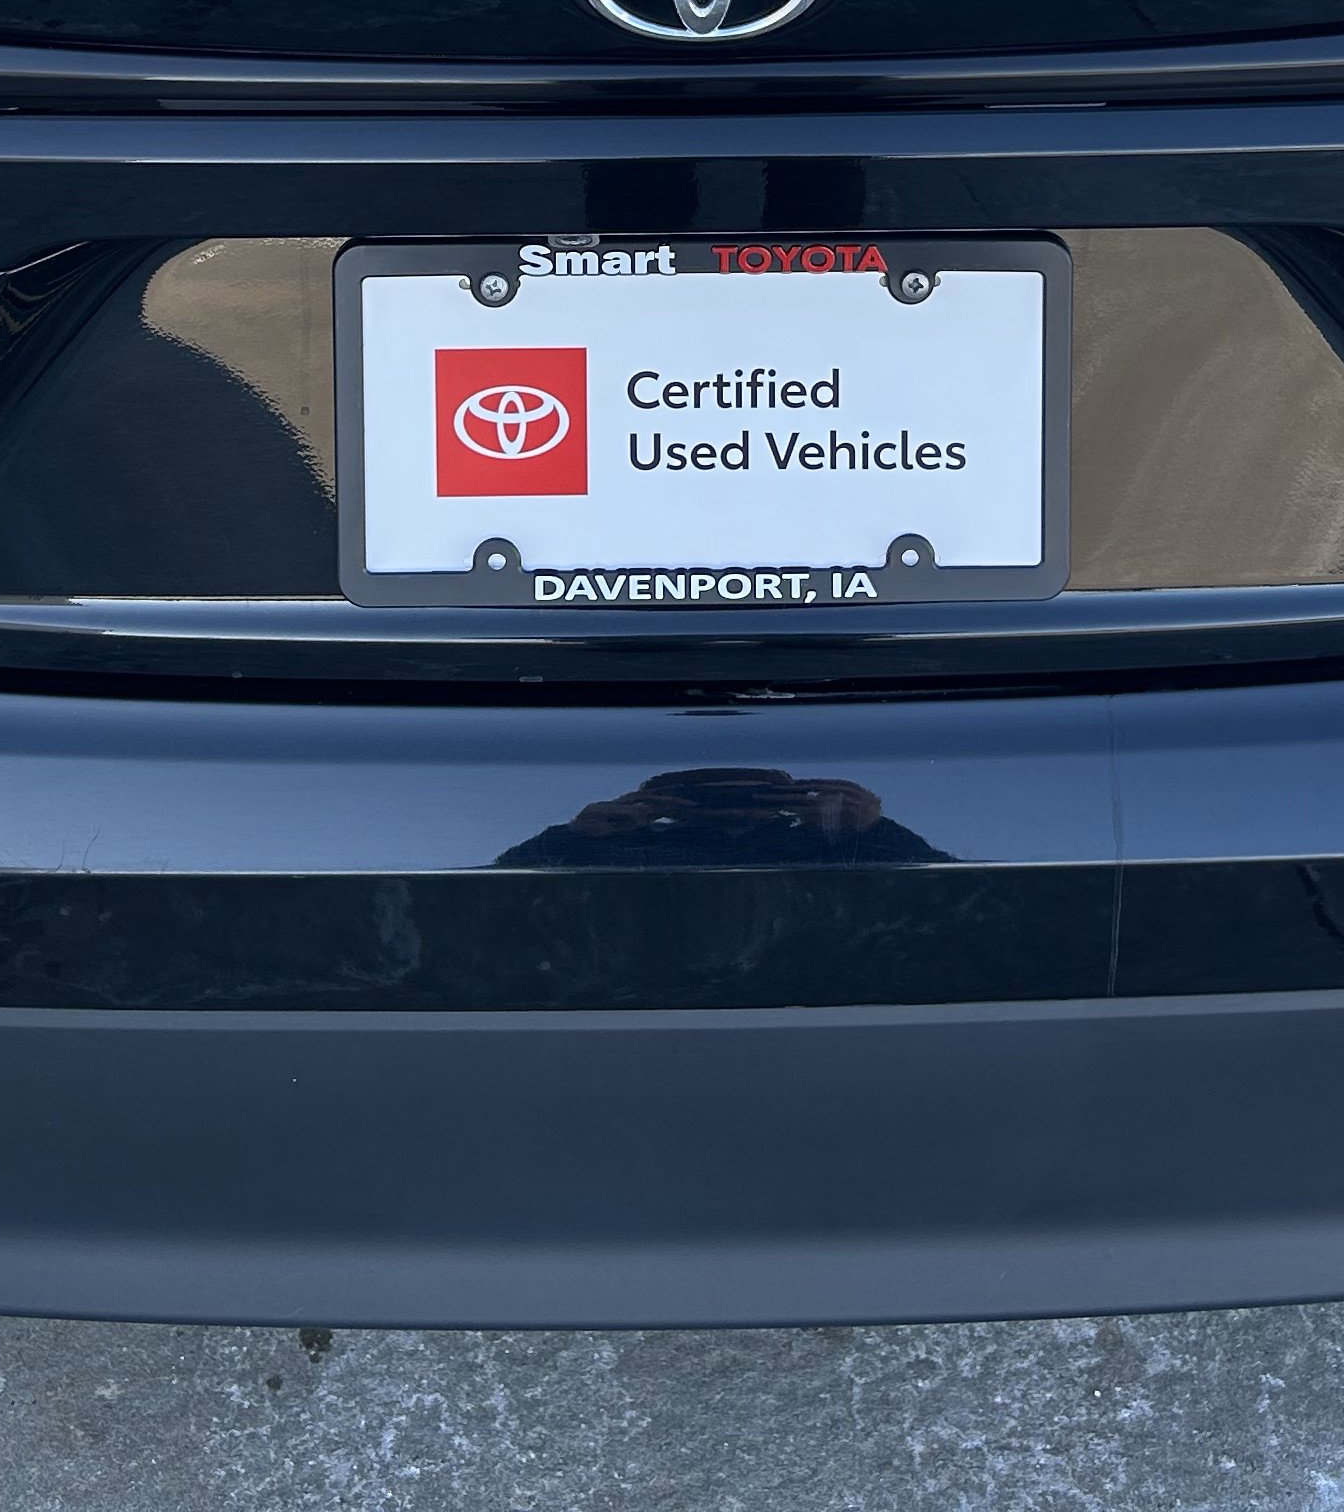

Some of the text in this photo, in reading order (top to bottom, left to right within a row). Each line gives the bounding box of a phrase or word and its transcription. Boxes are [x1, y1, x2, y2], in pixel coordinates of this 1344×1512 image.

[518, 244, 887, 277] Smart TOYOTA
[626, 368, 842, 409] Certified
[628, 431, 967, 471] Used Vehicles
[534, 573, 877, 604] DAVENPORT, IA
